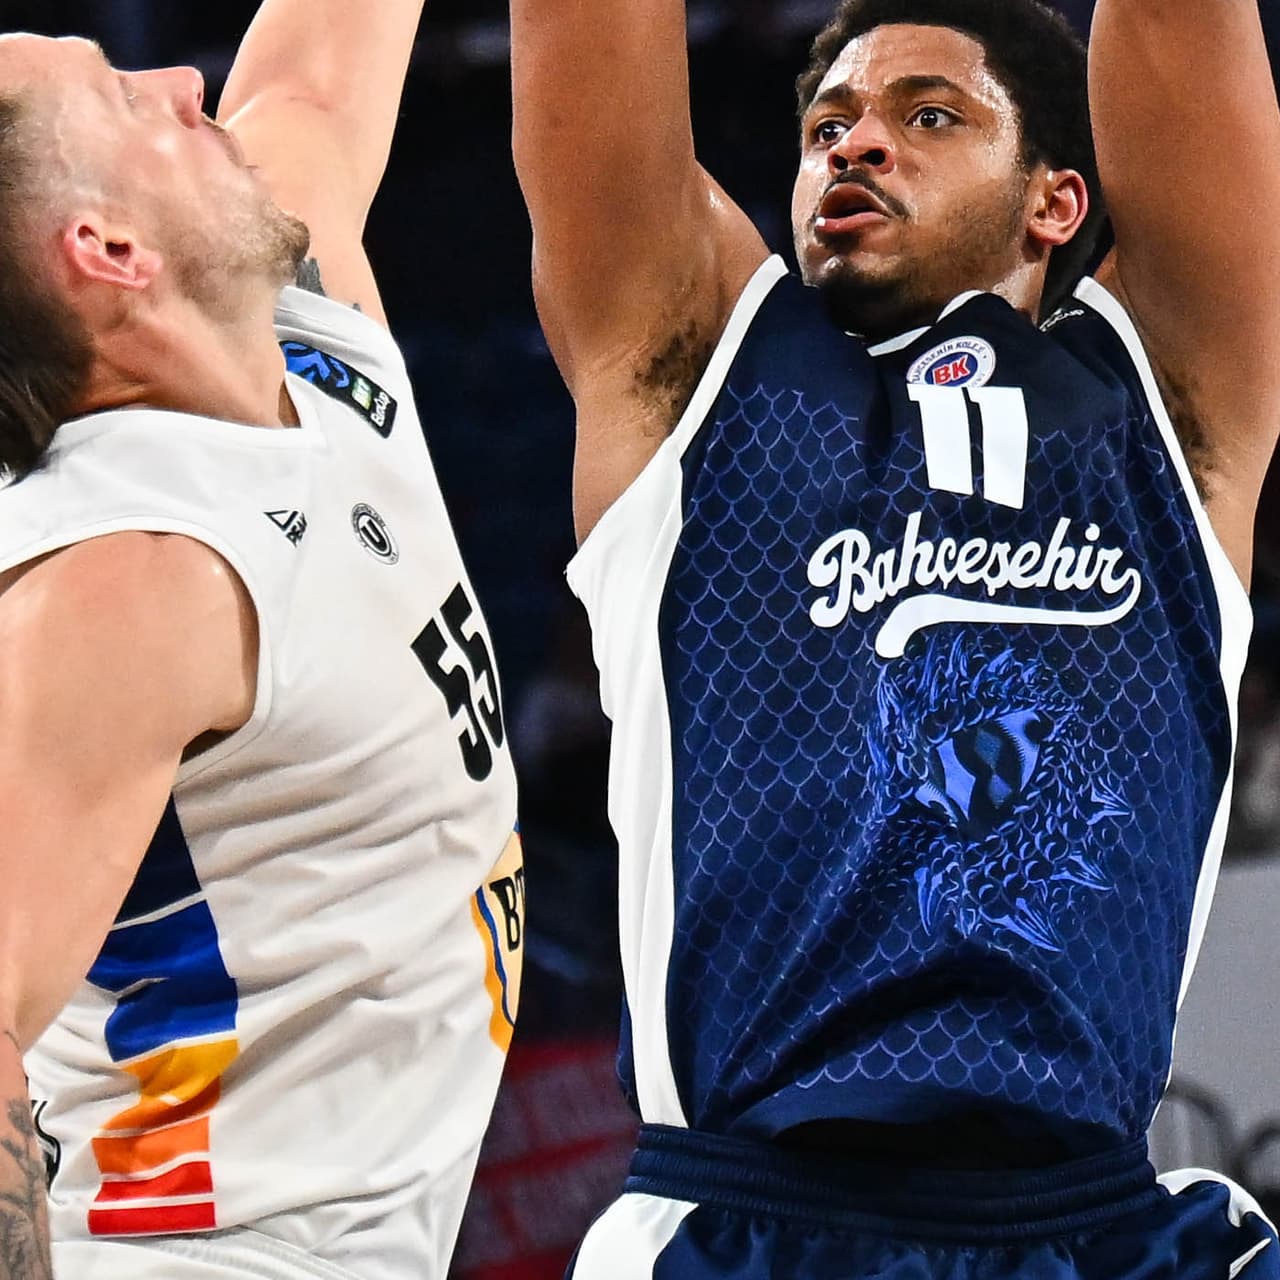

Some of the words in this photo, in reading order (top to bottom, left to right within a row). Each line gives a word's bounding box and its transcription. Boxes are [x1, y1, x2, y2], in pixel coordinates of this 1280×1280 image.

[931, 352, 971, 386] BK
[906, 381, 1029, 510] 11
[806, 510, 1142, 630] Bahçeşehir
[410, 581, 503, 783] 55
